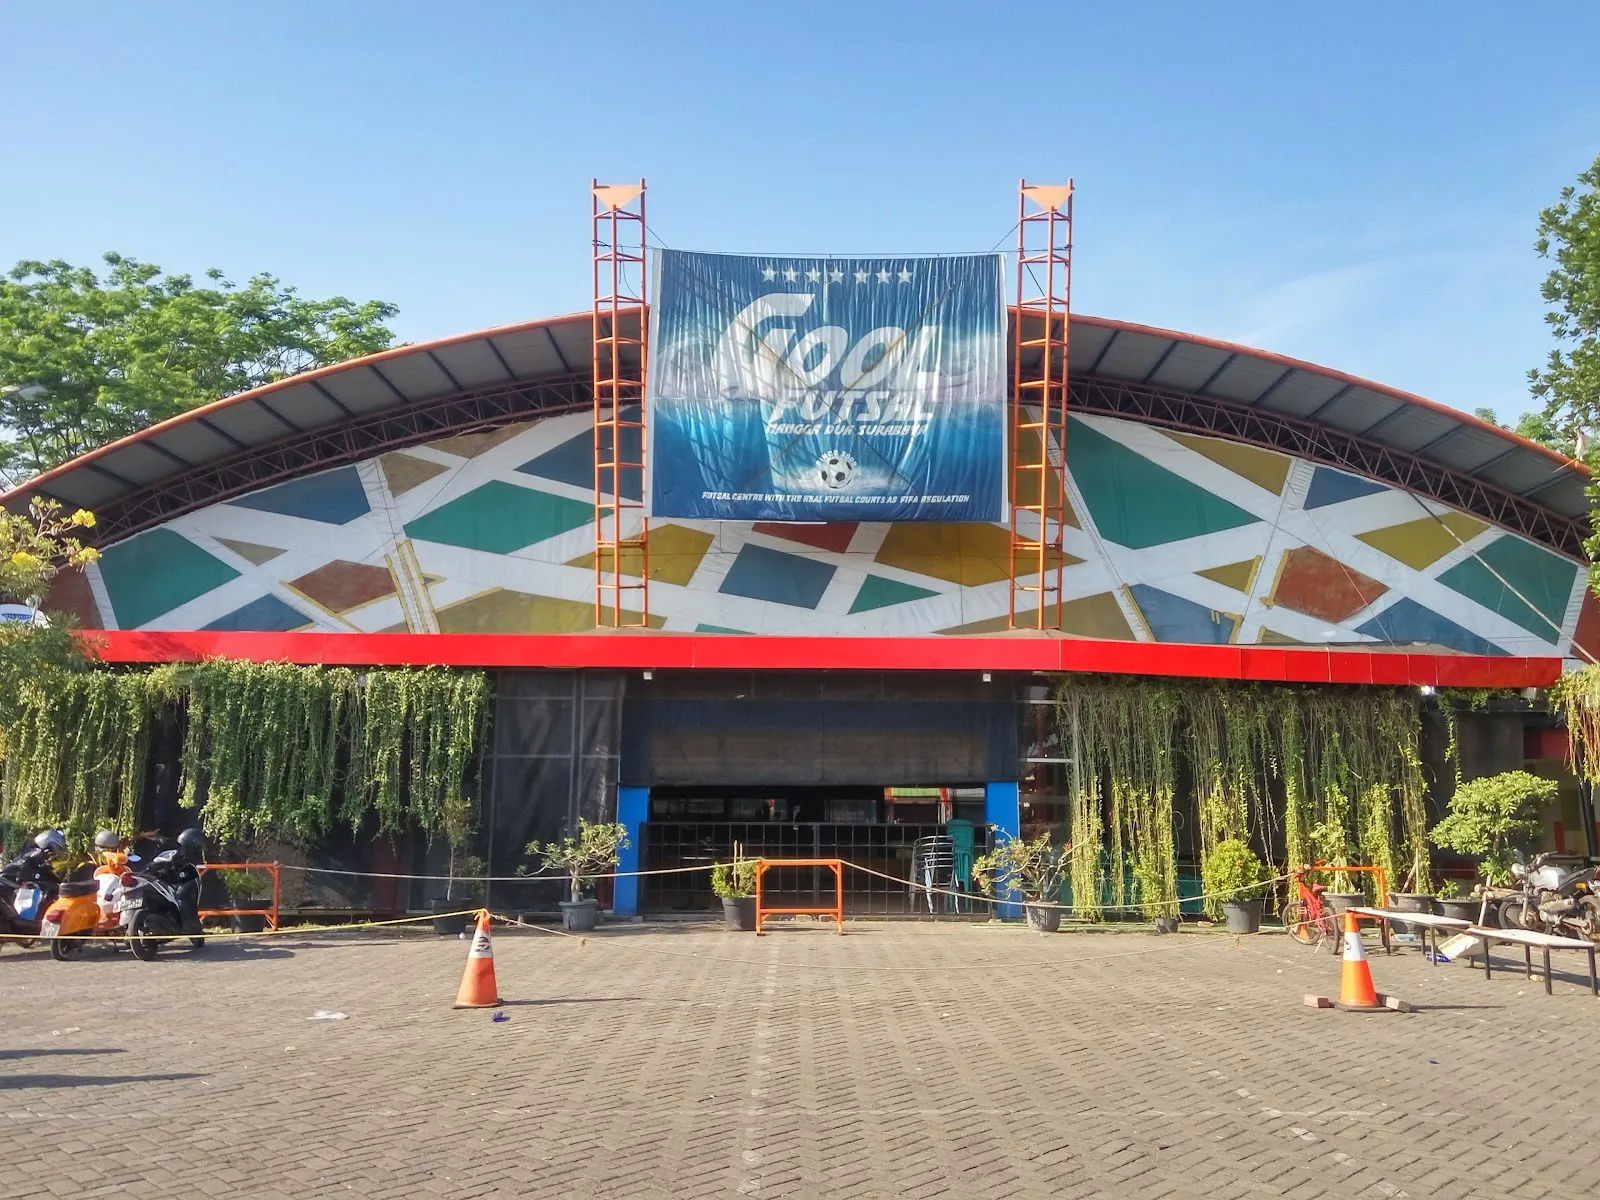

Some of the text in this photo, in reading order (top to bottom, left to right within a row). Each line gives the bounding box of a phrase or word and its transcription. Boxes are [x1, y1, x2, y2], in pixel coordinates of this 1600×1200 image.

[768, 390, 934, 423] FUTSAL
[766, 422, 929, 436] MANGGA DUA SURABAYA
[815, 449, 839, 467] SINCE
[702, 491, 731, 500] FUTSAL
[732, 493, 764, 501] CENTRE
[765, 494, 786, 502] WITH
[787, 494, 802, 502] THE
[803, 495, 823, 503] REAL
[920, 495, 970, 503] REGULATION
